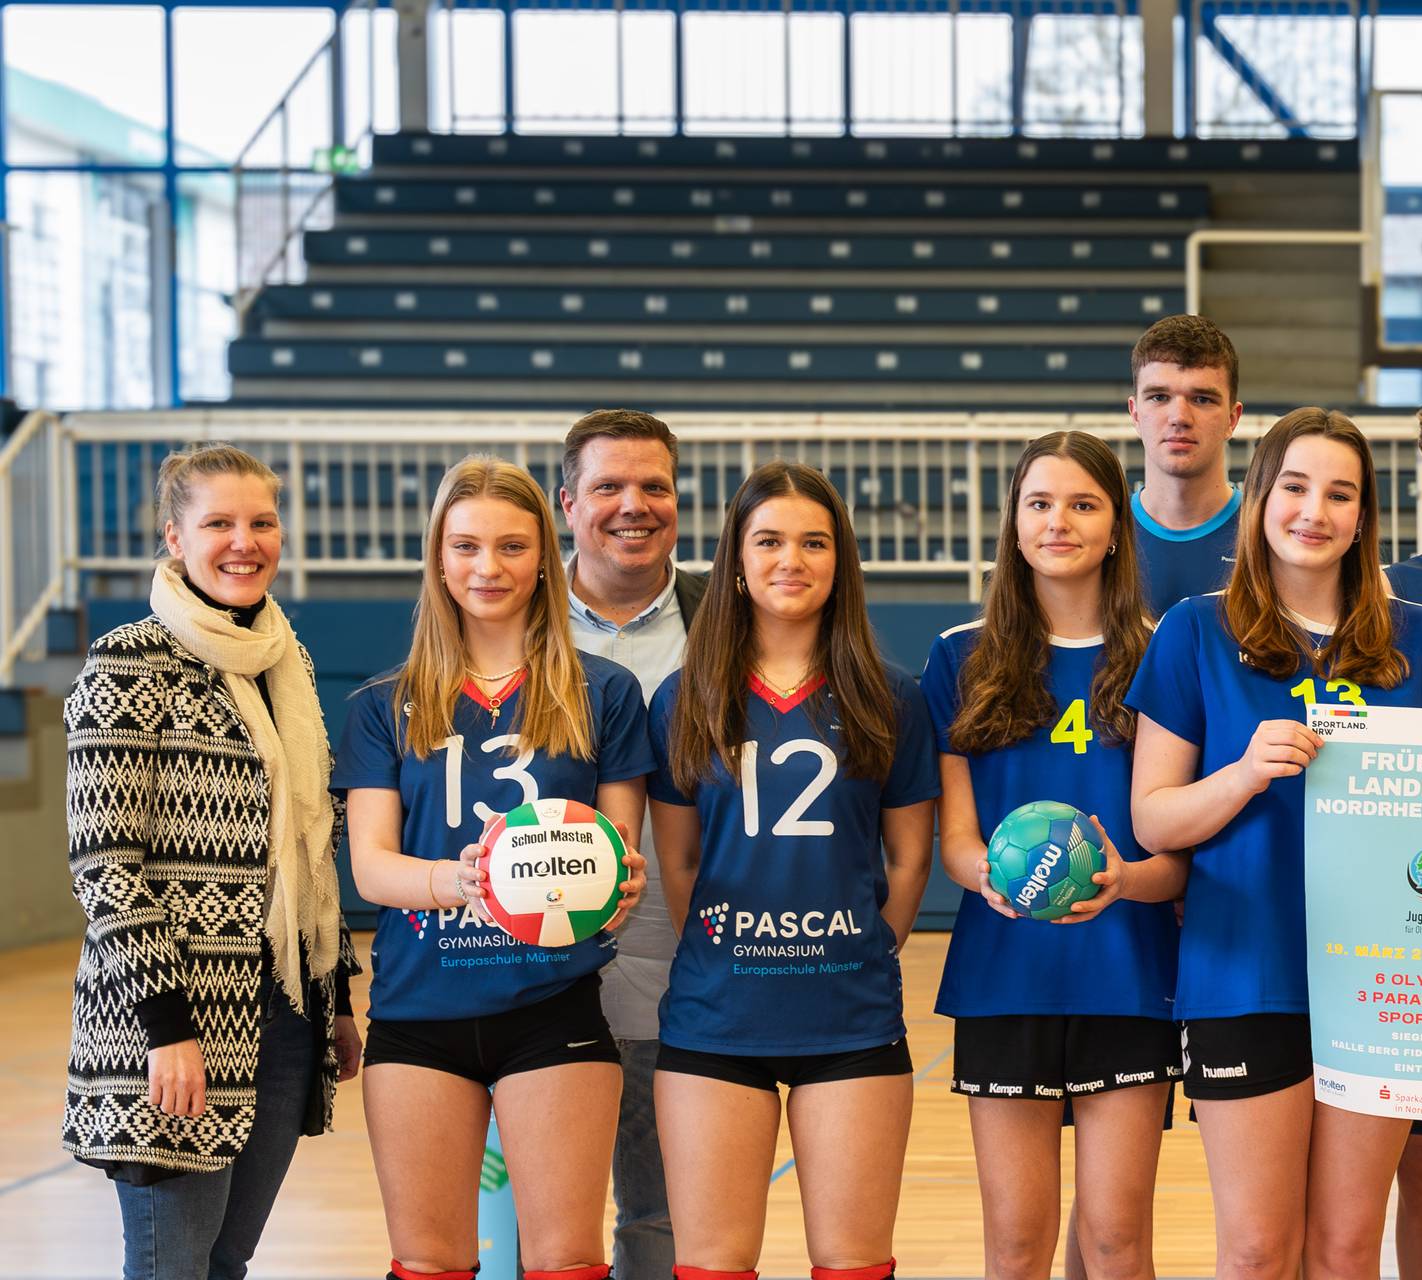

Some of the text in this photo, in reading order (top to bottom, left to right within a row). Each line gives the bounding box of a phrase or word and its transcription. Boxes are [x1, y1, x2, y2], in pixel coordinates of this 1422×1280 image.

[1050, 699, 1093, 755] 4
[1311, 720, 1368, 730] SPORTLAND.
[433, 734, 539, 828] 13
[733, 738, 837, 837] 12
[512, 831, 547, 848] School
[511, 856, 595, 879] molten
[1016, 844, 1062, 906] molten
[735, 909, 863, 938] PASCAL
[733, 944, 825, 958] GYMNASIUM
[1355, 944, 1406, 959] MÄRZ
[441, 952, 570, 968] Europaschule Münster
[733, 960, 864, 978] Europaschule Münster
[1375, 973, 1385, 985] 6
[1357, 990, 1367, 1002] 3
[1331, 1039, 1364, 1052] HALLE
[1368, 1046, 1399, 1056] BERG
[1202, 1062, 1248, 1078] hummel
[959, 1080, 980, 1094] Kempa
[989, 1083, 1023, 1096] Kempa
[1035, 1085, 1063, 1099] Kemp
[1066, 1078, 1104, 1093] Kempa
[1115, 1069, 1155, 1083] Kempa
[1318, 1077, 1346, 1092] molten
